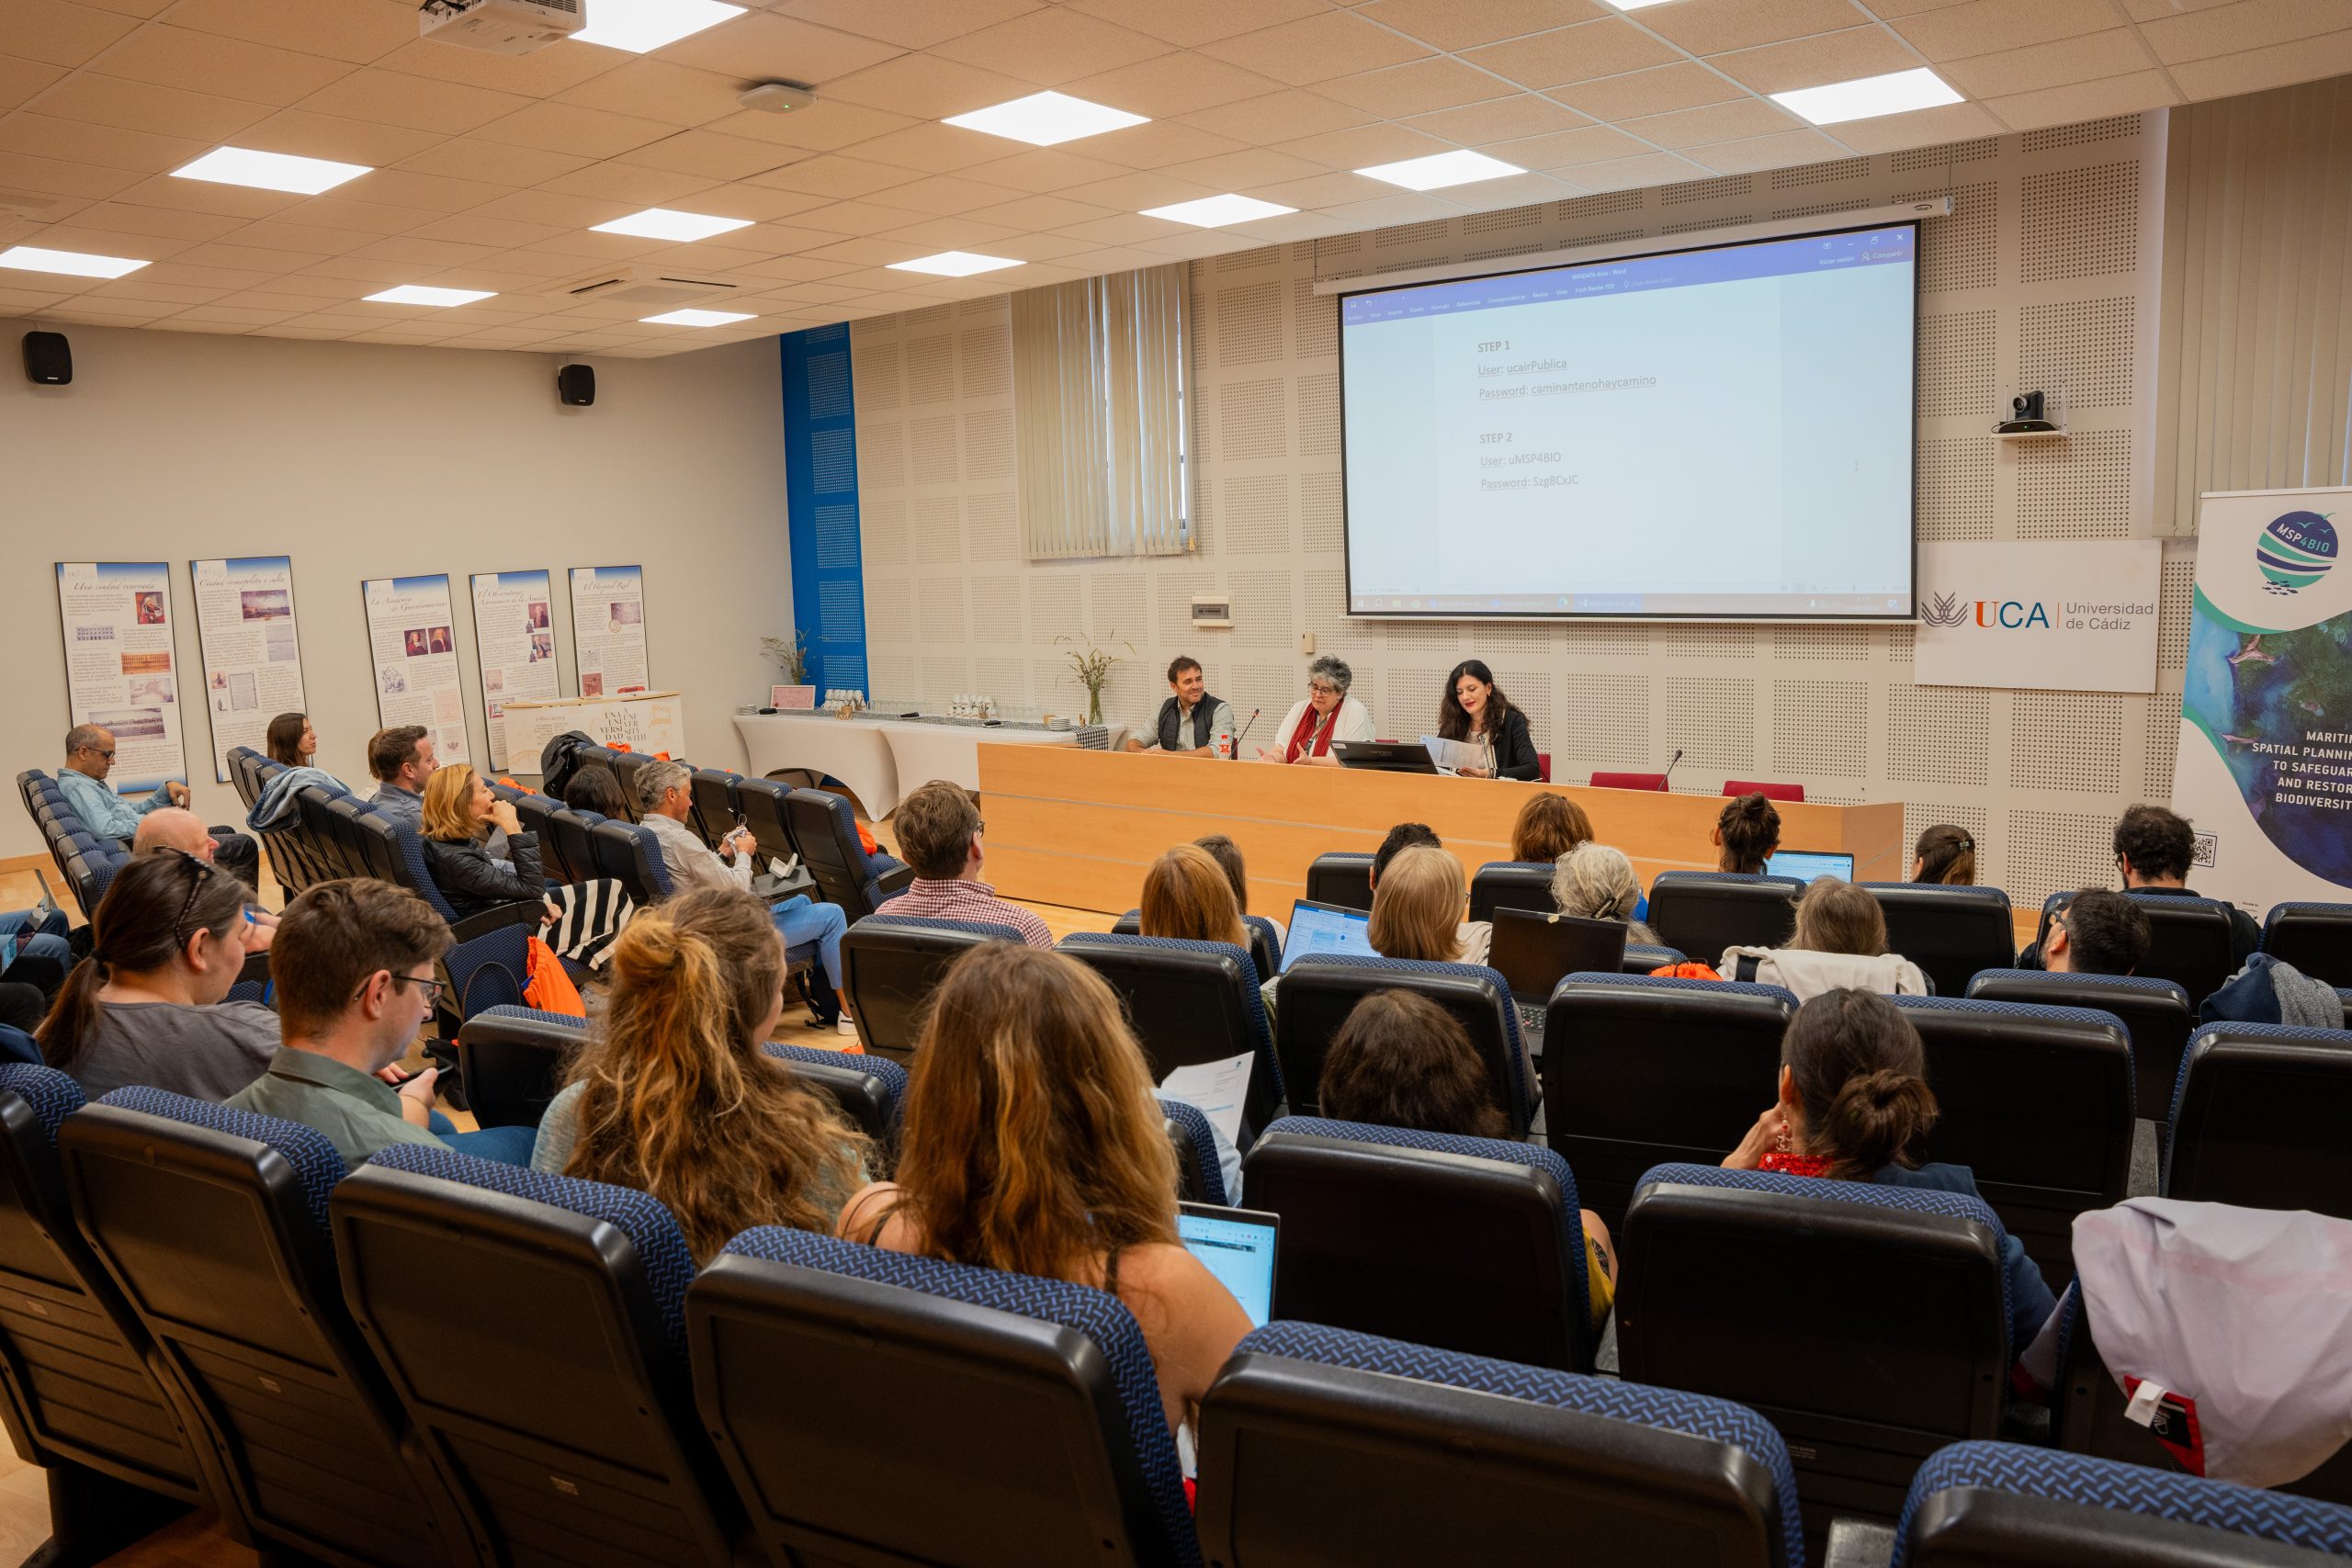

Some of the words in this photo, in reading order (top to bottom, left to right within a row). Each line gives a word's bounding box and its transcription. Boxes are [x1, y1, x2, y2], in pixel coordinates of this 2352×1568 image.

[1819, 256, 1837, 265] Iniciar
[1872, 250, 1904, 260] Compartir
[1477, 342, 1502, 353] STEP
[1505, 341, 1511, 351] 1
[1478, 365, 1504, 376] User:
[1479, 385, 1529, 399] Password:
[1532, 375, 1657, 394] caminantenohaycamino
[1479, 433, 1504, 444] STEP
[1506, 432, 1512, 442] 2
[1480, 456, 1506, 467] User:
[1509, 452, 1562, 465] uMSP4BIO
[1481, 477, 1531, 490] Password:
[2277, 523, 2330, 553] MSP4BIO
[96, 578, 123, 591] ciudad
[199, 575, 229, 587] Ciudad
[1973, 602, 2050, 629] UCA
[2066, 602, 2154, 615] Universidad
[2065, 618, 2084, 629] de
[2088, 617, 2132, 630] Cádiz
[600, 726, 623, 734] VERSI
[625, 727, 639, 735] SITY
[605, 733, 624, 741] DAD
[626, 733, 647, 741] WITH
[2306, 731, 2352, 744] MARITI
[2252, 742, 2299, 756] SPATIAL
[2273, 761, 2288, 771] TO
[2291, 762, 2352, 777] SAFEGUAR
[2278, 777, 2301, 788] AND
[2306, 780, 2352, 794] RESTOR
[2275, 793, 2352, 810] BIODIVERSIT
